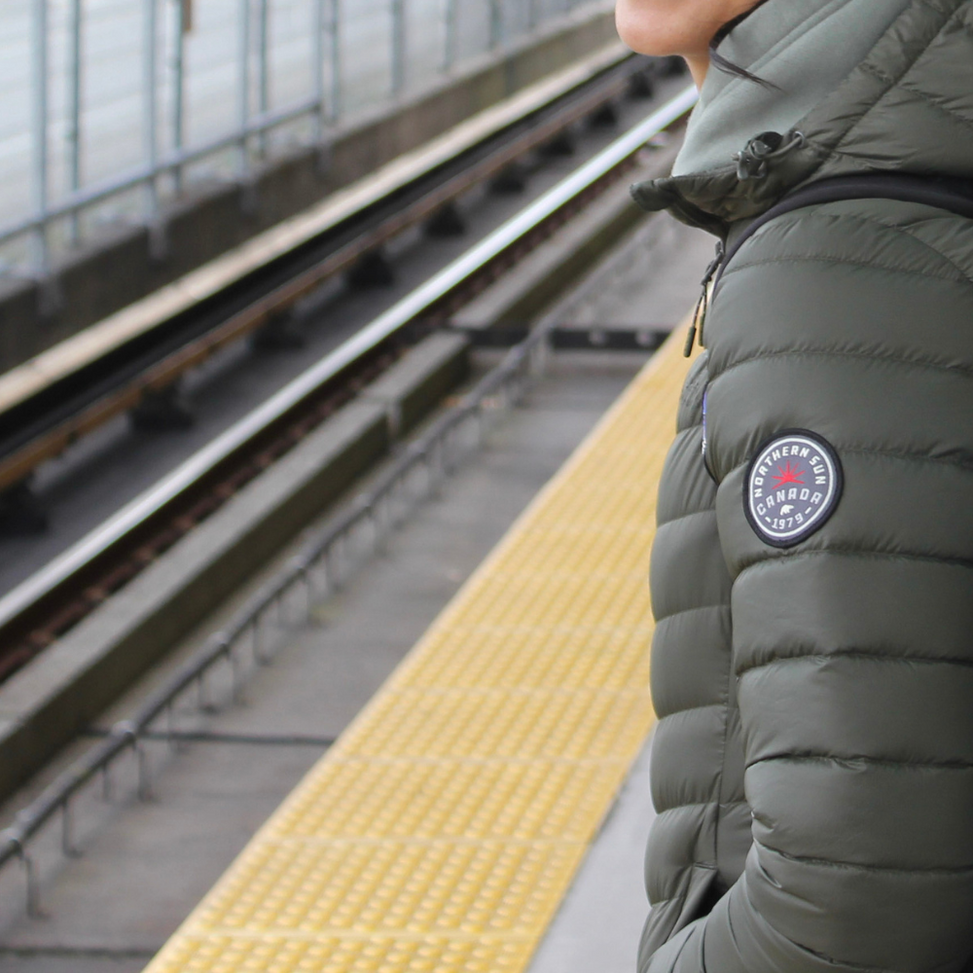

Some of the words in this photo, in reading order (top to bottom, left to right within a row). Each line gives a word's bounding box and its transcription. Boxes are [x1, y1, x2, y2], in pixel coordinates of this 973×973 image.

[754, 445, 810, 498] NORTHERN
[809, 455, 826, 485] SUN
[756, 487, 823, 516] CANADA
